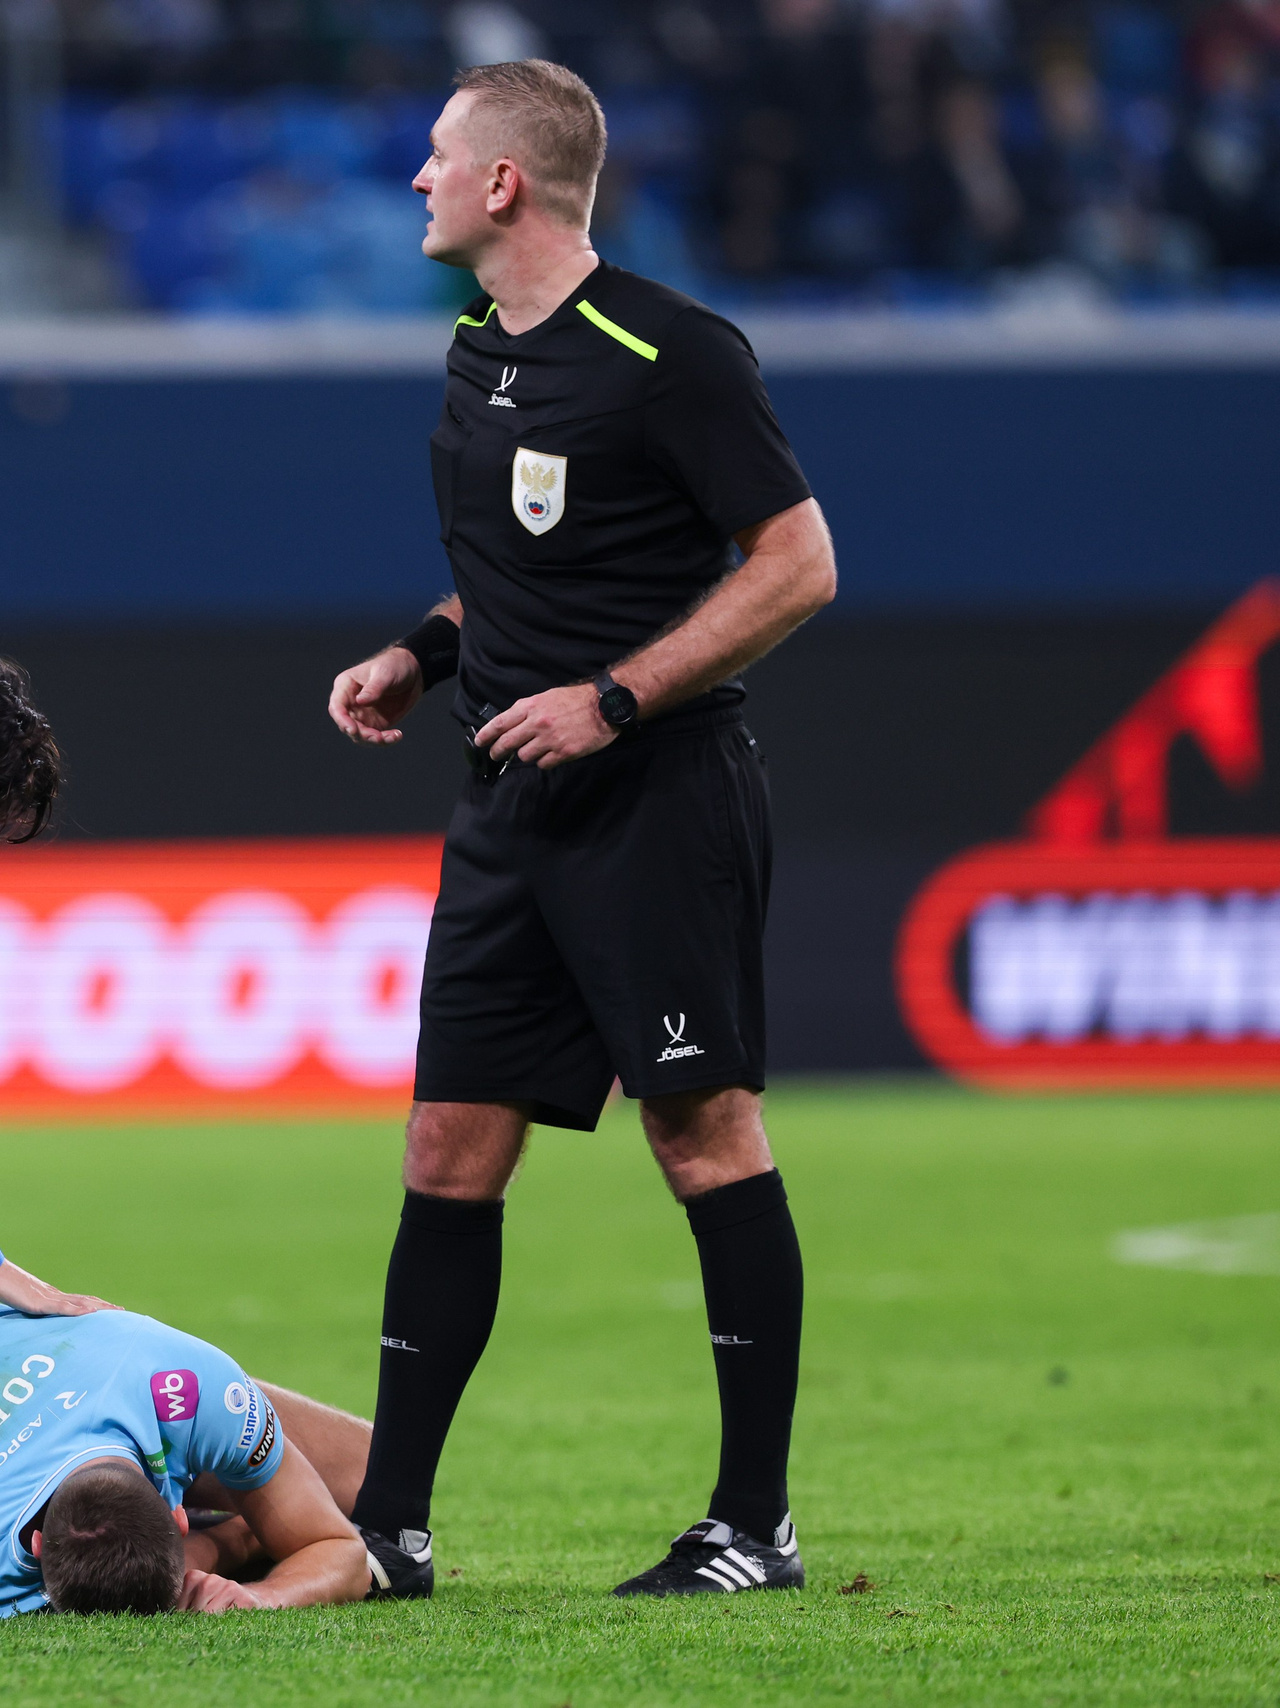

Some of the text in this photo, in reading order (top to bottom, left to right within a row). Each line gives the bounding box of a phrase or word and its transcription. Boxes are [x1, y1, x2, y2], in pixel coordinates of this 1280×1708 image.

[656, 1044, 706, 1063] JÖGEL
[380, 1335, 420, 1353] GEL
[158, 1373, 187, 1420] wb
